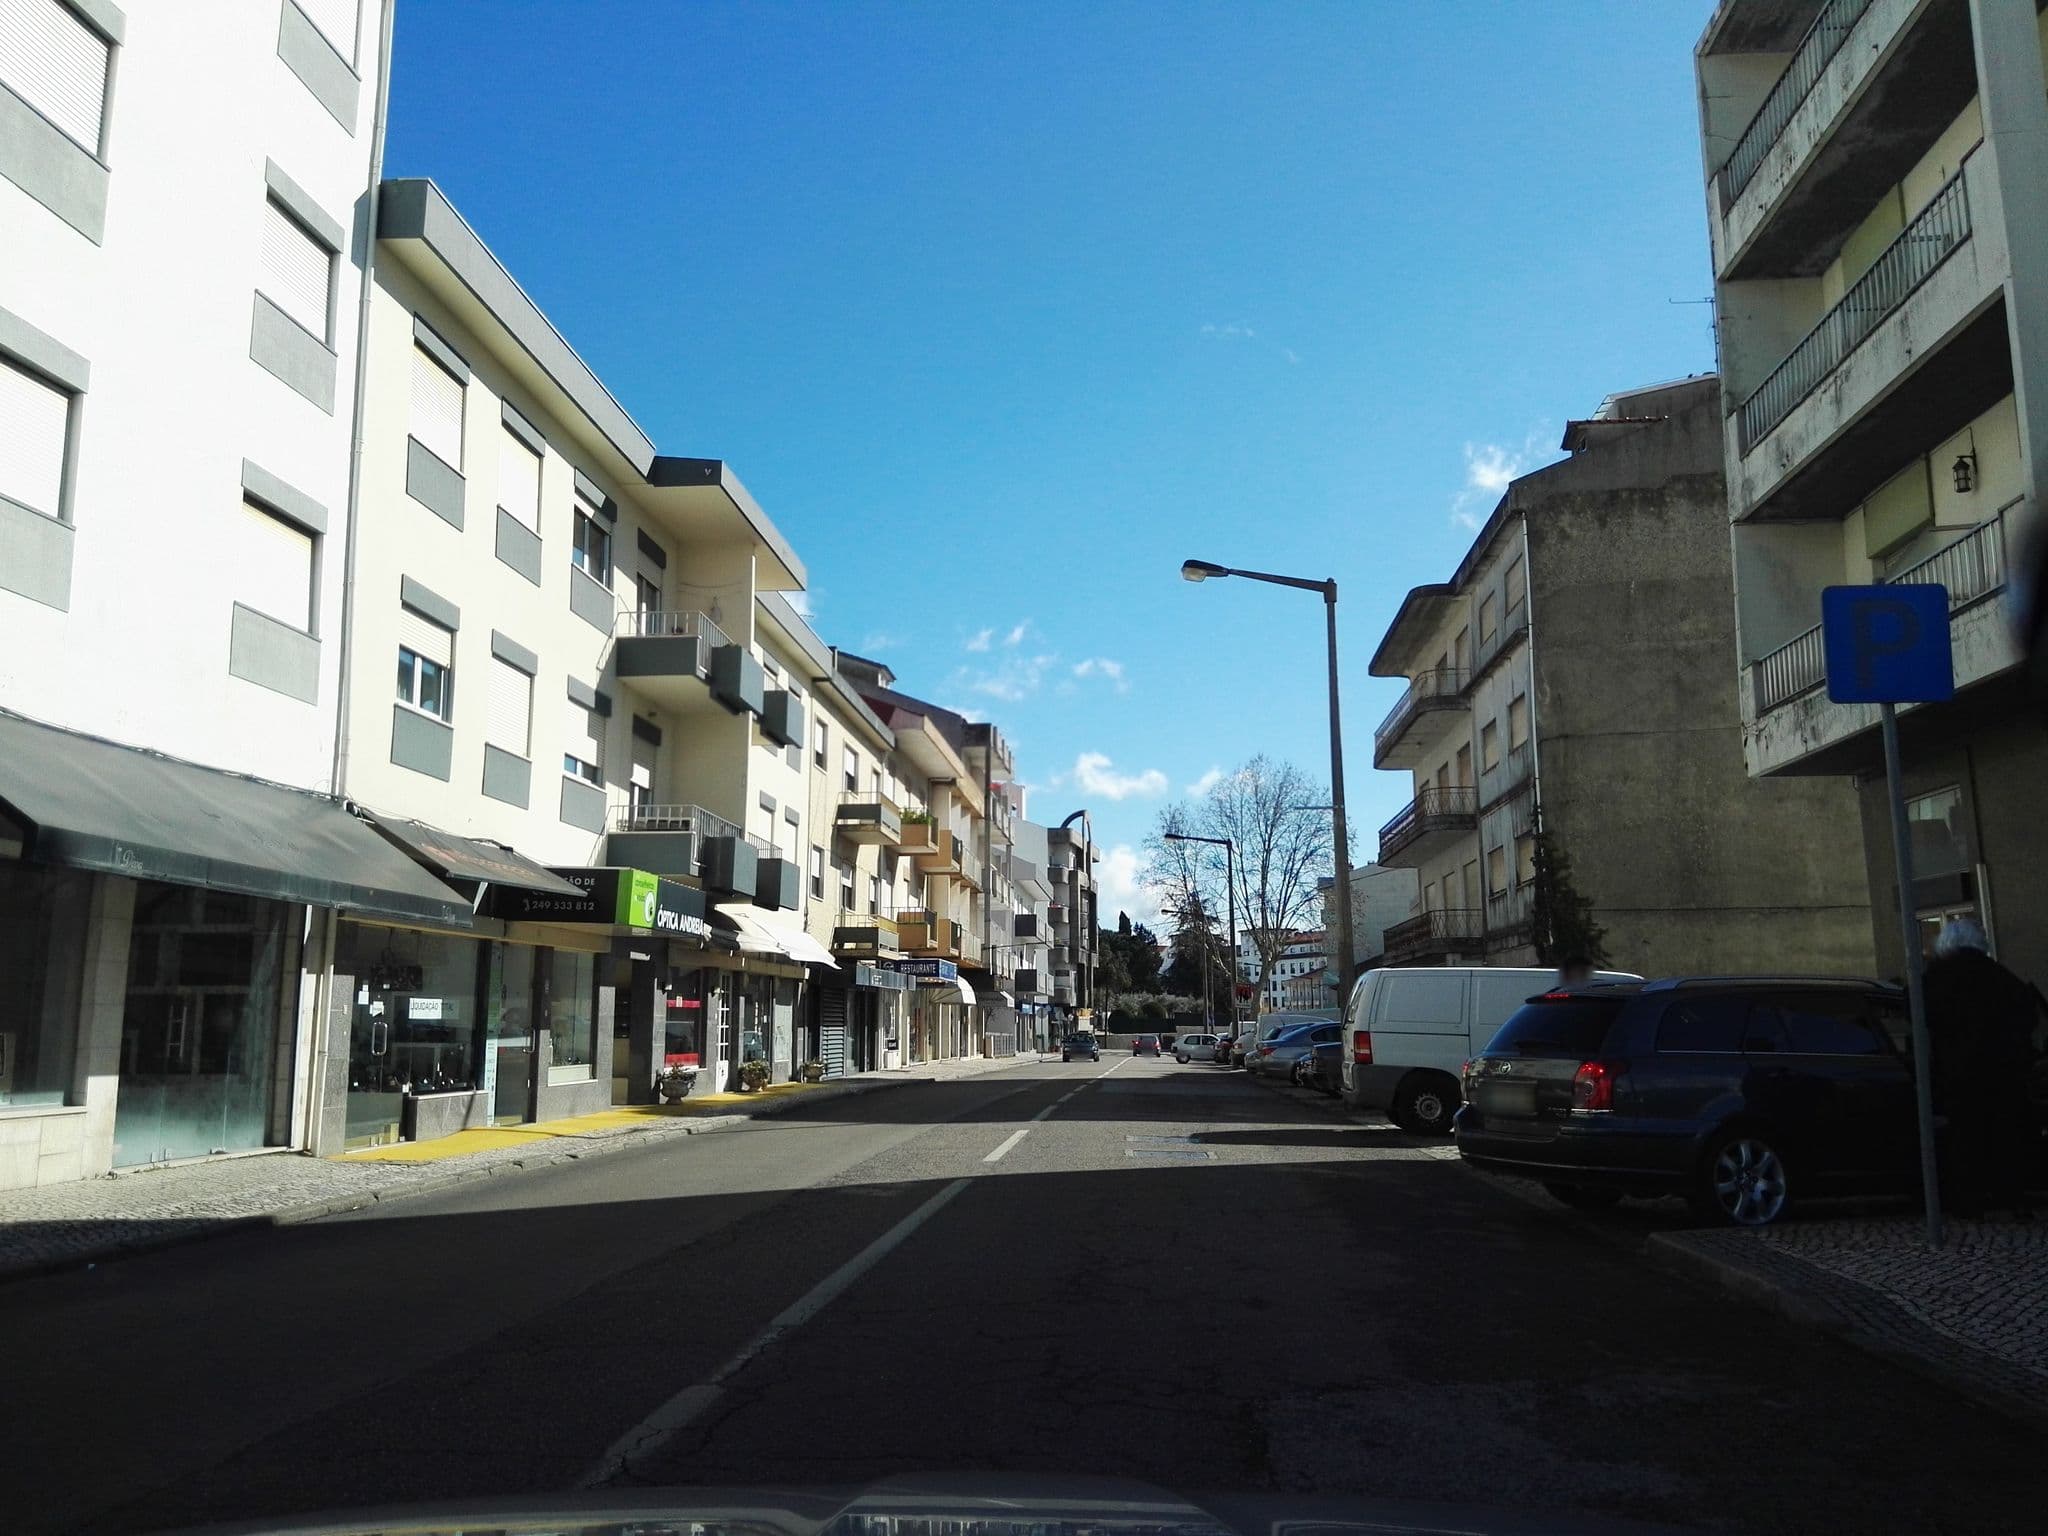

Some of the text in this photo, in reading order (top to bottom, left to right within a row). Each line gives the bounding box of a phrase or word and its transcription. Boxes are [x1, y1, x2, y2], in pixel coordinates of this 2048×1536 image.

[1853, 599, 1921, 688] P
[584, 878, 596, 886] DE
[575, 902, 595, 911] 812
[657, 904, 679, 931] ÓPTICA
[900, 963, 937, 974] RESTAURANTE
